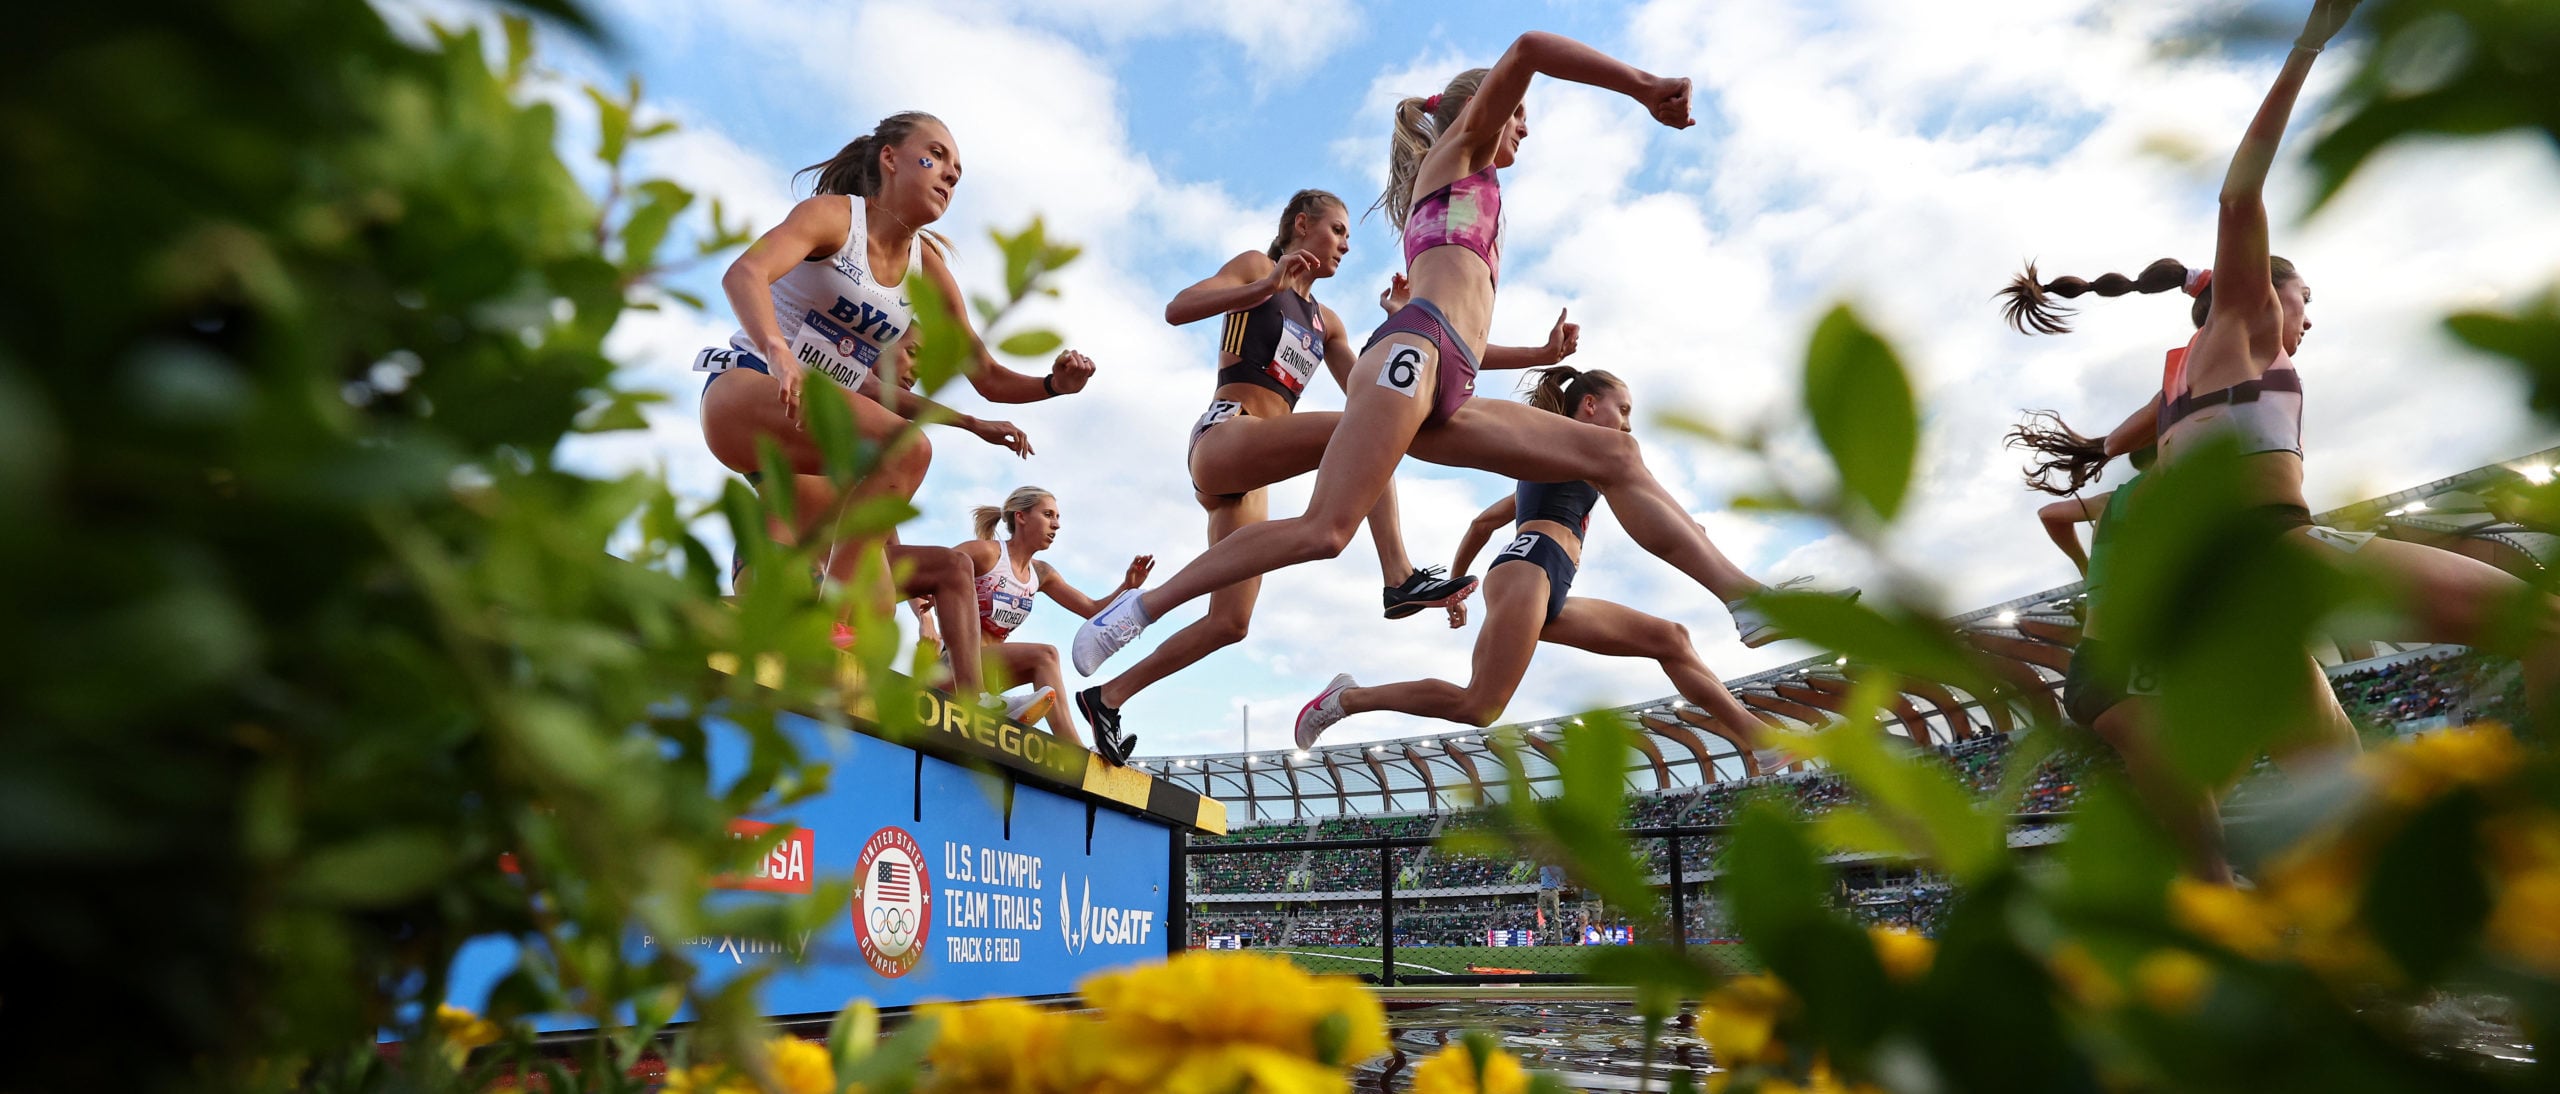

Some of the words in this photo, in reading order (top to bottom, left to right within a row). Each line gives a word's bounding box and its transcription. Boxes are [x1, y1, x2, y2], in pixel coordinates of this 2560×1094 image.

[828, 295, 900, 343] BYU
[702, 347, 731, 370] 14
[798, 342, 861, 388] HALLADAY
[1280, 345, 1313, 376] JENNINGS
[1388, 349, 1421, 388] 6
[862, 831, 893, 866] UNITED
[896, 832, 924, 873] STATES
[945, 841, 976, 883] U.S.
[981, 847, 1042, 891] OLYMPIC
[945, 888, 988, 929] TEAM
[992, 893, 1042, 931] TRIALS
[1091, 906, 1155, 945] USATF
[701, 933, 713, 949] by
[861, 936, 898, 974] OLYMPIC
[902, 939, 923, 970] TEAM
[947, 936, 982, 963] TRACK
[985, 937, 992, 962] &
[994, 937, 1020, 963] FIELD
